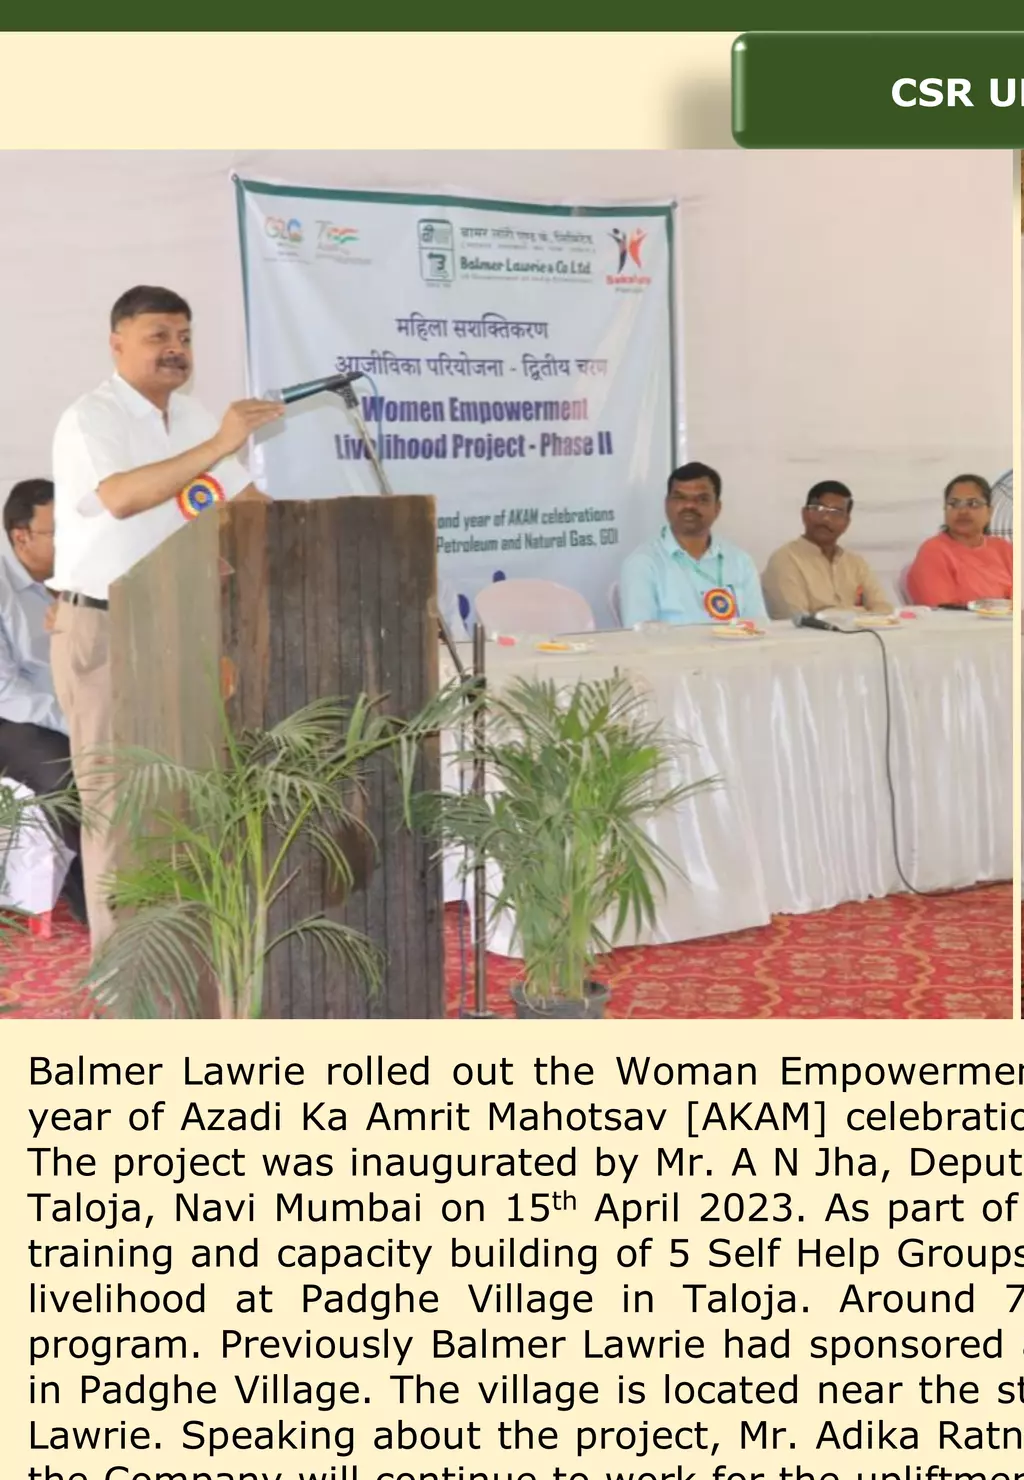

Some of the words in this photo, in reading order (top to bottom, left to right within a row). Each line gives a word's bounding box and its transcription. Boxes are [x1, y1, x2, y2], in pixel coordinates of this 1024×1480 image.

[892, 78, 974, 107] CSR
[460, 255, 504, 270] Balmer
[506, 257, 546, 273] Lawrie
[395, 312, 448, 341] महिला
[453, 312, 549, 340] सशक्तिकरण
[334, 349, 422, 376] आजीविका
[426, 351, 504, 378] परियोजना
[522, 352, 570, 382] द्वितीय
[361, 396, 446, 422] Women
[448, 396, 589, 425] Empowerment
[452, 433, 526, 462] Project
[541, 431, 594, 458] Phase
[598, 430, 614, 456] II
[437, 510, 460, 530] ond
[464, 512, 492, 531] year
[493, 509, 507, 528] of
[508, 508, 540, 527] AKAM
[541, 506, 616, 525] celebrations
[436, 535, 499, 554] Petroleum
[501, 533, 522, 551] and
[524, 531, 567, 550] Natural
[569, 529, 597, 548] Gas,
[600, 527, 619, 546] GOI
[31, 1055, 163, 1085] Balmer
[185, 1057, 304, 1085] Lawrie
[328, 1055, 428, 1085] rolled
[453, 1058, 513, 1085] out
[534, 1056, 593, 1085] the
[616, 1057, 756, 1085] Woman
[27, 1147, 95, 1176] The
[115, 1148, 245, 1183] project
[263, 1154, 333, 1176] was
[352, 1147, 575, 1183] inaugurated
[597, 1147, 638, 1183] by
[658, 1148, 712, 1176] Mr.
[732, 1148, 753, 1176] A
[776, 1148, 797, 1176] N
[816, 1147, 889, 1183] Jha,
[27, 1192, 153, 1229] Taloja,
[176, 1193, 254, 1222] Navi
[277, 1192, 420, 1222] Mumbai
[442, 1200, 484, 1222] on
[508, 1190, 576, 1222] 15th
[595, 1192, 678, 1229] April
[701, 1193, 803, 1222] 2023.
[825, 1193, 869, 1222] As
[890, 1194, 964, 1229] part
[983, 1192, 1019, 1222] of
[31, 1421, 160, 1449] Lawrie.
[183, 1420, 353, 1457] Speaking
[374, 1420, 480, 1449] about
[498, 1420, 557, 1449] the
[578, 1421, 719, 1457] project,
[741, 1421, 795, 1449] Mr.
[816, 1420, 918, 1449] Adika
